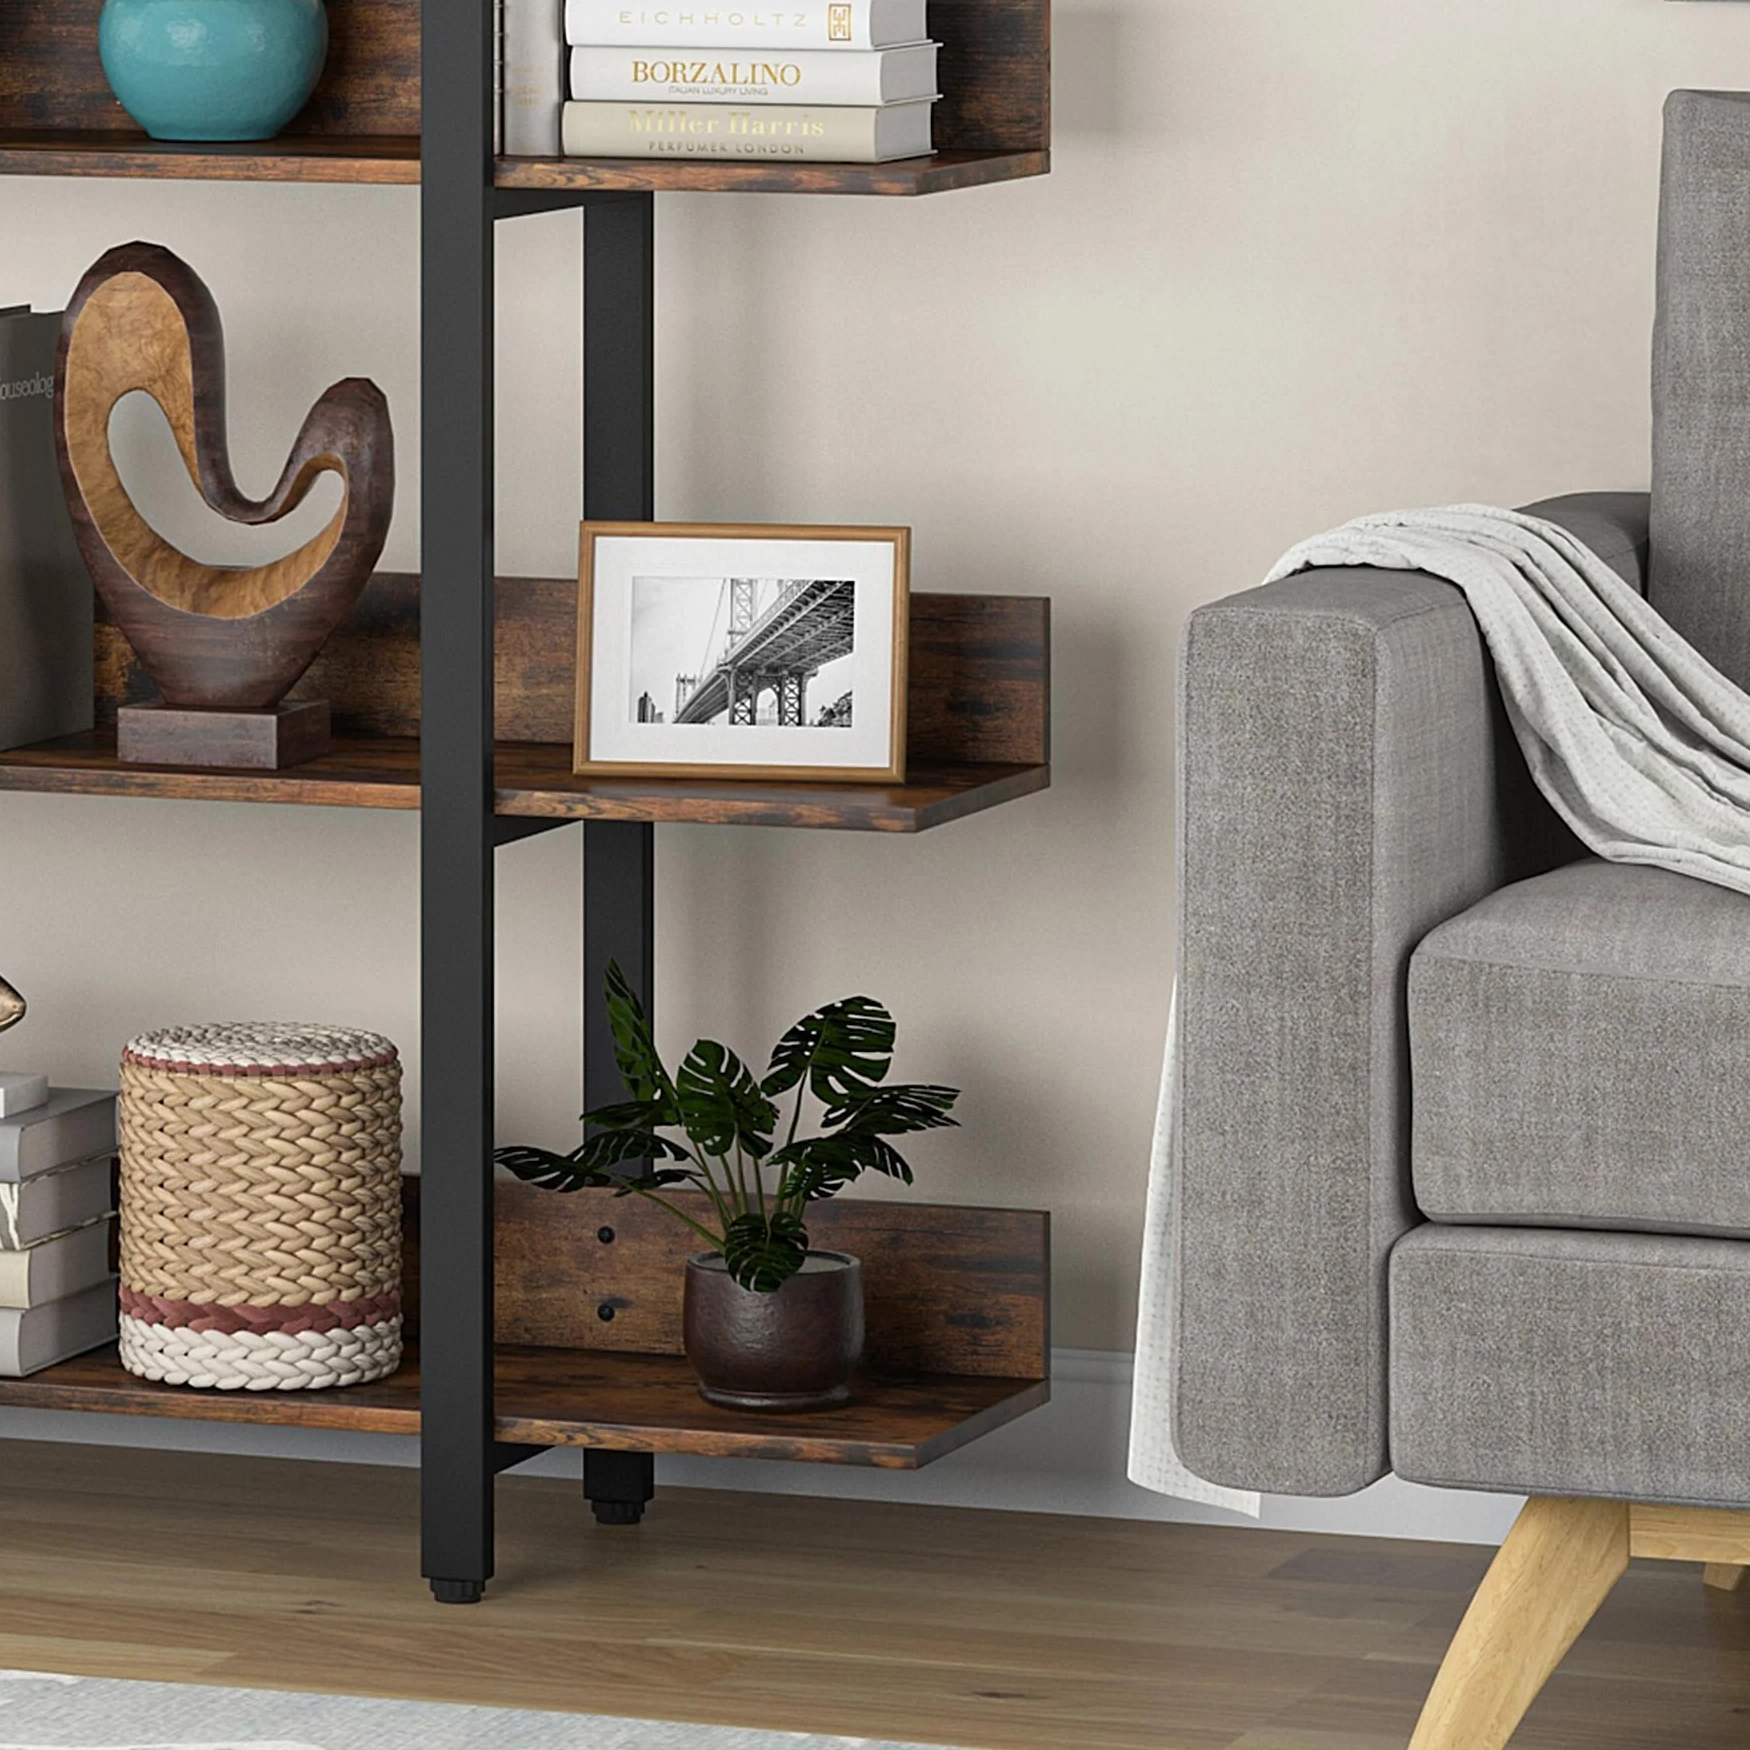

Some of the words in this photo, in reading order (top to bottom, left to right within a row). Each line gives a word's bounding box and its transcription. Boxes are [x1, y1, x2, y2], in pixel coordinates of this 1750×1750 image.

[618, 10, 807, 28] EICHHOLTZ
[631, 60, 802, 86] BORZALINO
[628, 110, 720, 134] Miller
[728, 111, 825, 136] Harris
[649, 141, 727, 153] PERFUMER
[735, 142, 805, 154] LONDON
